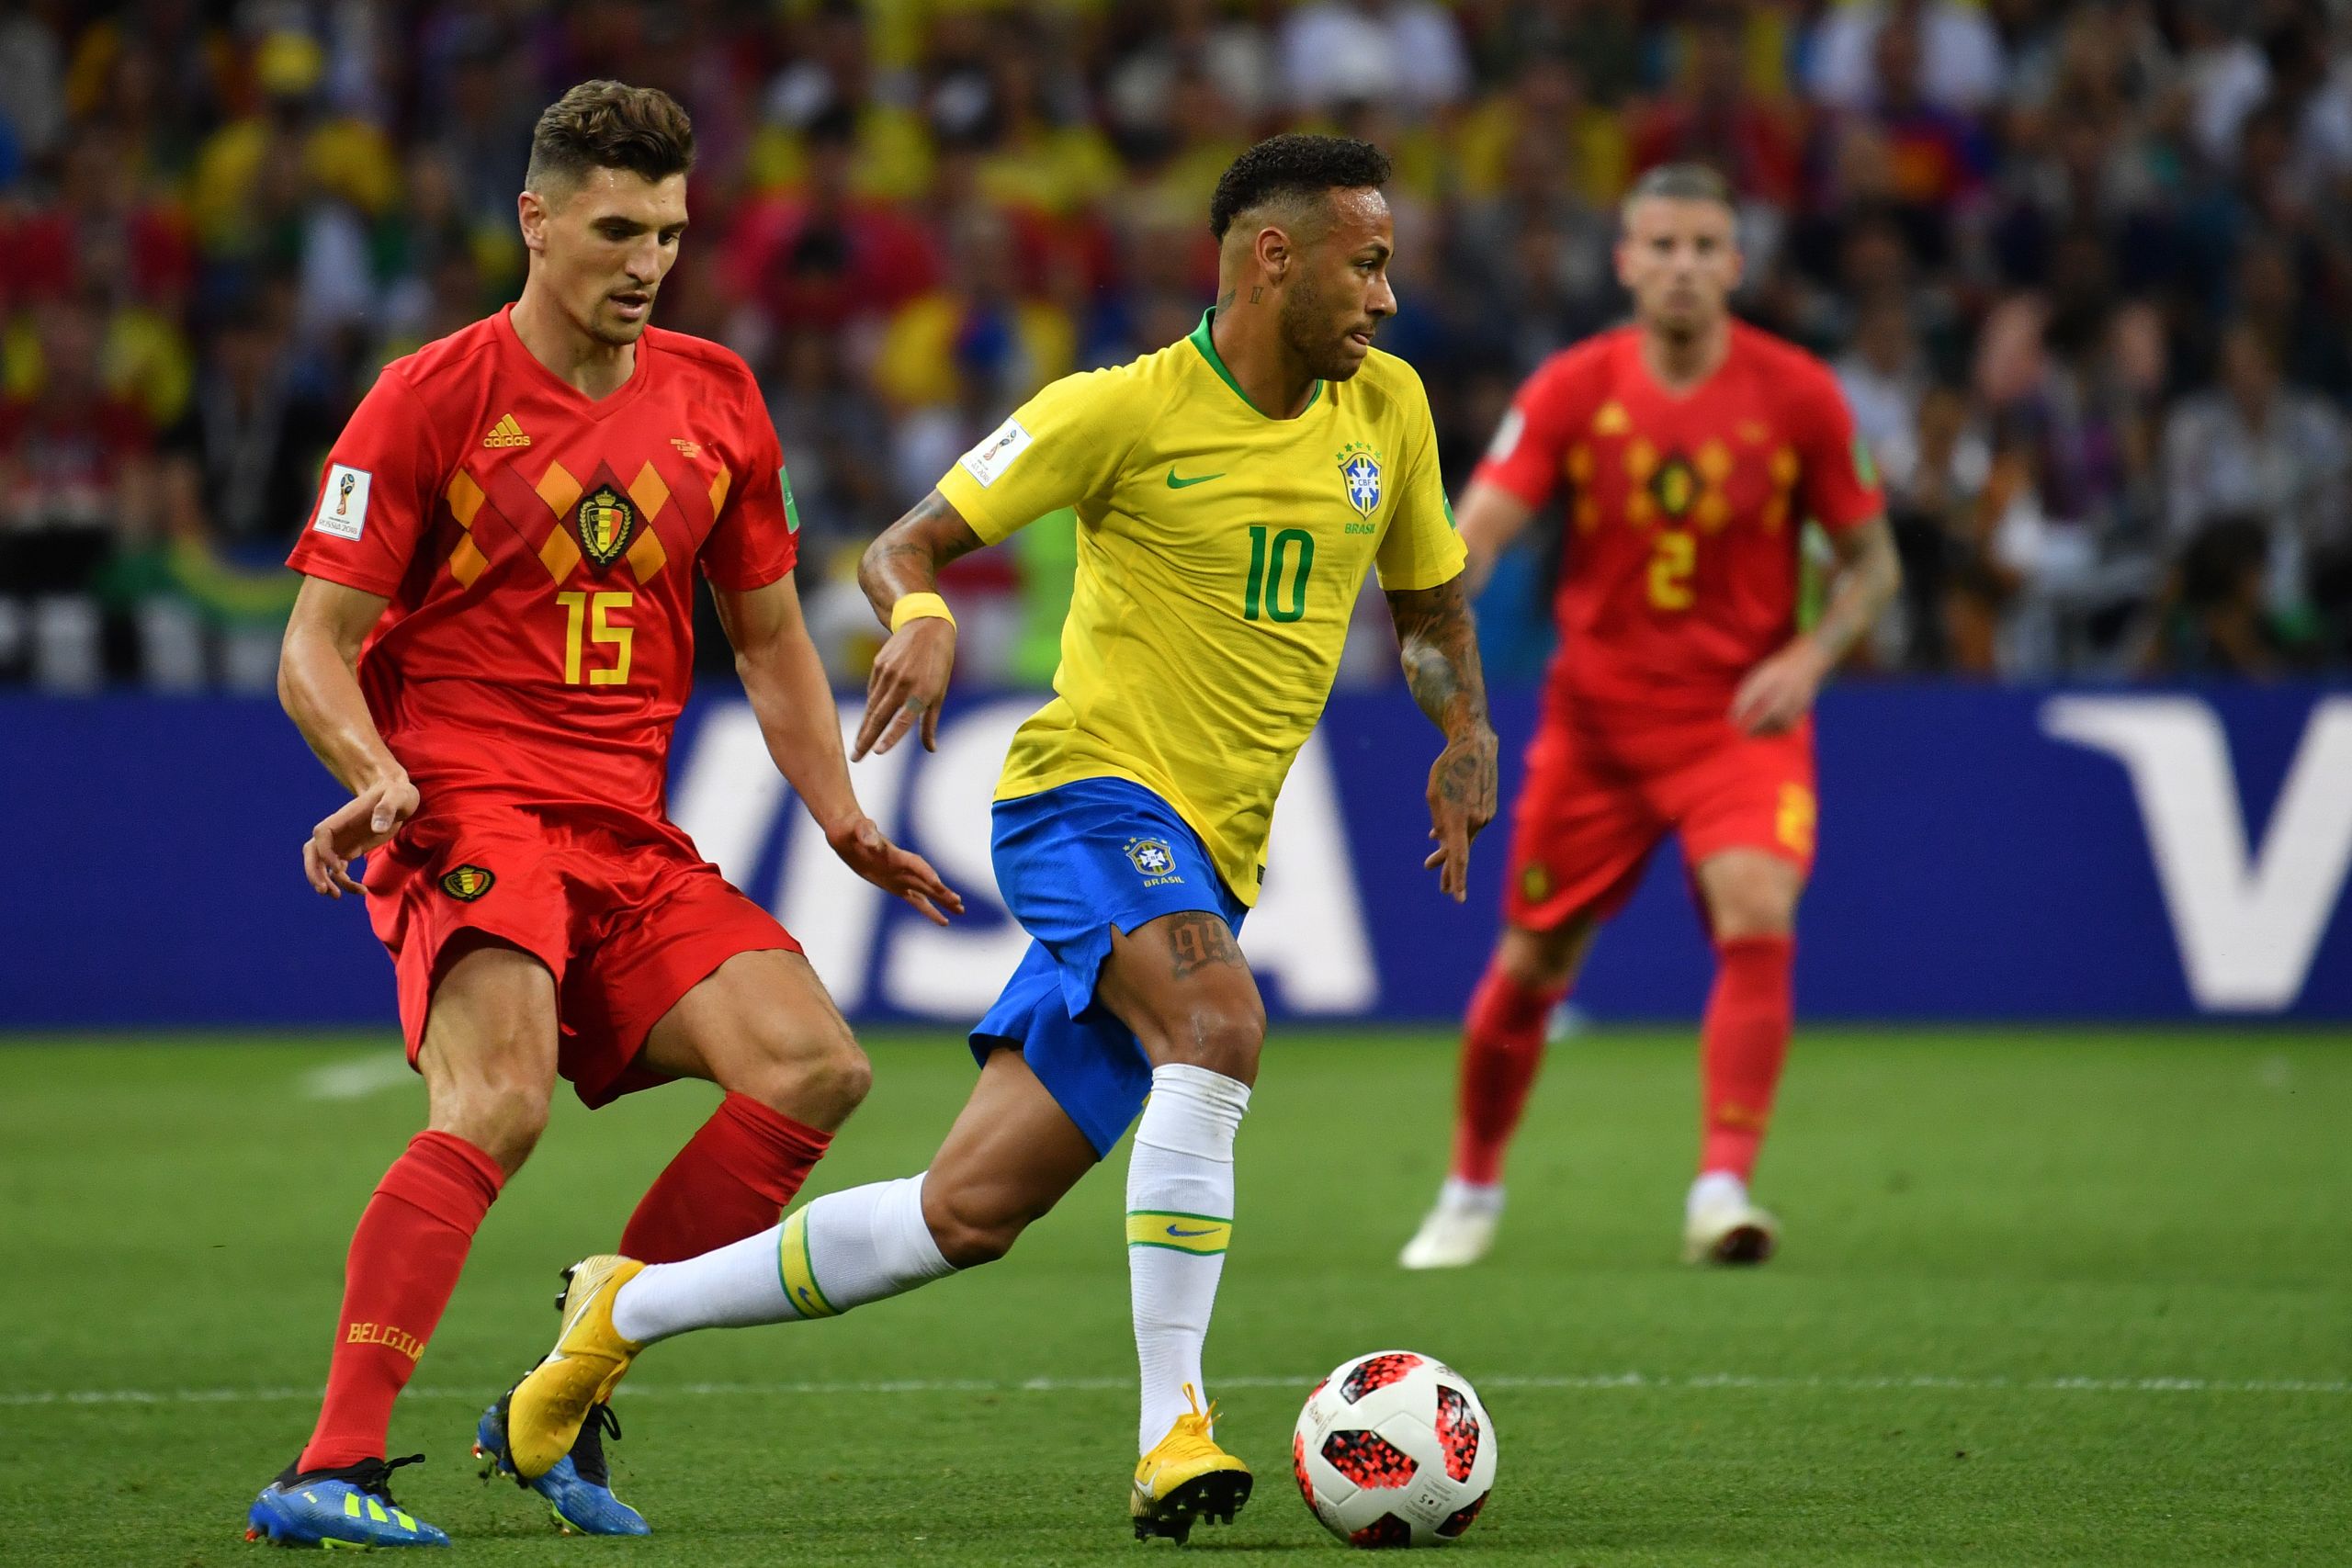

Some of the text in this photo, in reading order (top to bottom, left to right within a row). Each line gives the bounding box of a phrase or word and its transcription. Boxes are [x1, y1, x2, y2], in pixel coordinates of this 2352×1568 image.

[483, 435, 531, 448] adidas
[1358, 479, 1372, 487] CBF
[1344, 523, 1376, 535] BRASIL
[1243, 525, 1315, 623] 10
[1647, 529, 1697, 611] 2
[556, 591, 635, 685] 15
[1143, 875, 1185, 888] BRASIL
[346, 1322, 424, 1362] BELGIU
